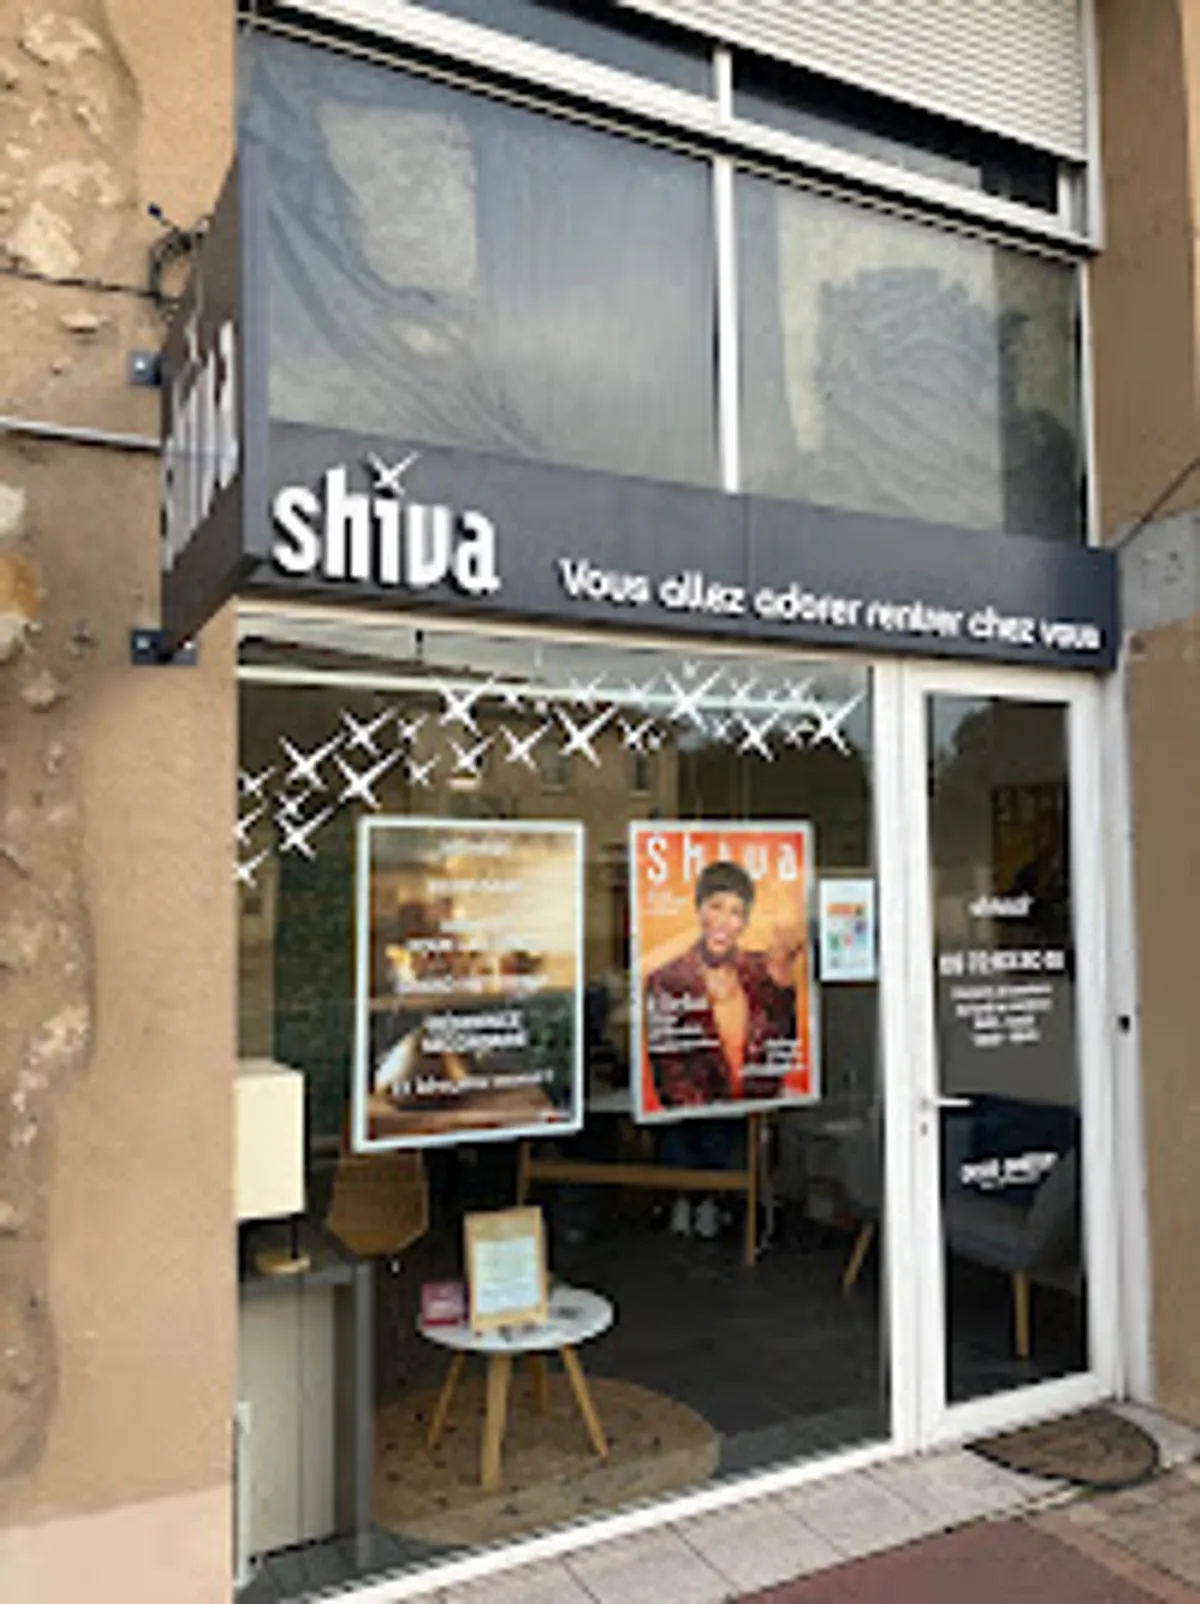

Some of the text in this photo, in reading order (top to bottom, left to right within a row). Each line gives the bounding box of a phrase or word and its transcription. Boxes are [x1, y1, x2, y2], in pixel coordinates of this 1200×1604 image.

[273, 455, 500, 593] shiva
[558, 557, 651, 605] Vous
[657, 571, 746, 616] allez
[753, 581, 863, 627] adorer
[967, 605, 1036, 647] chez
[1038, 620, 1101, 651] vous
